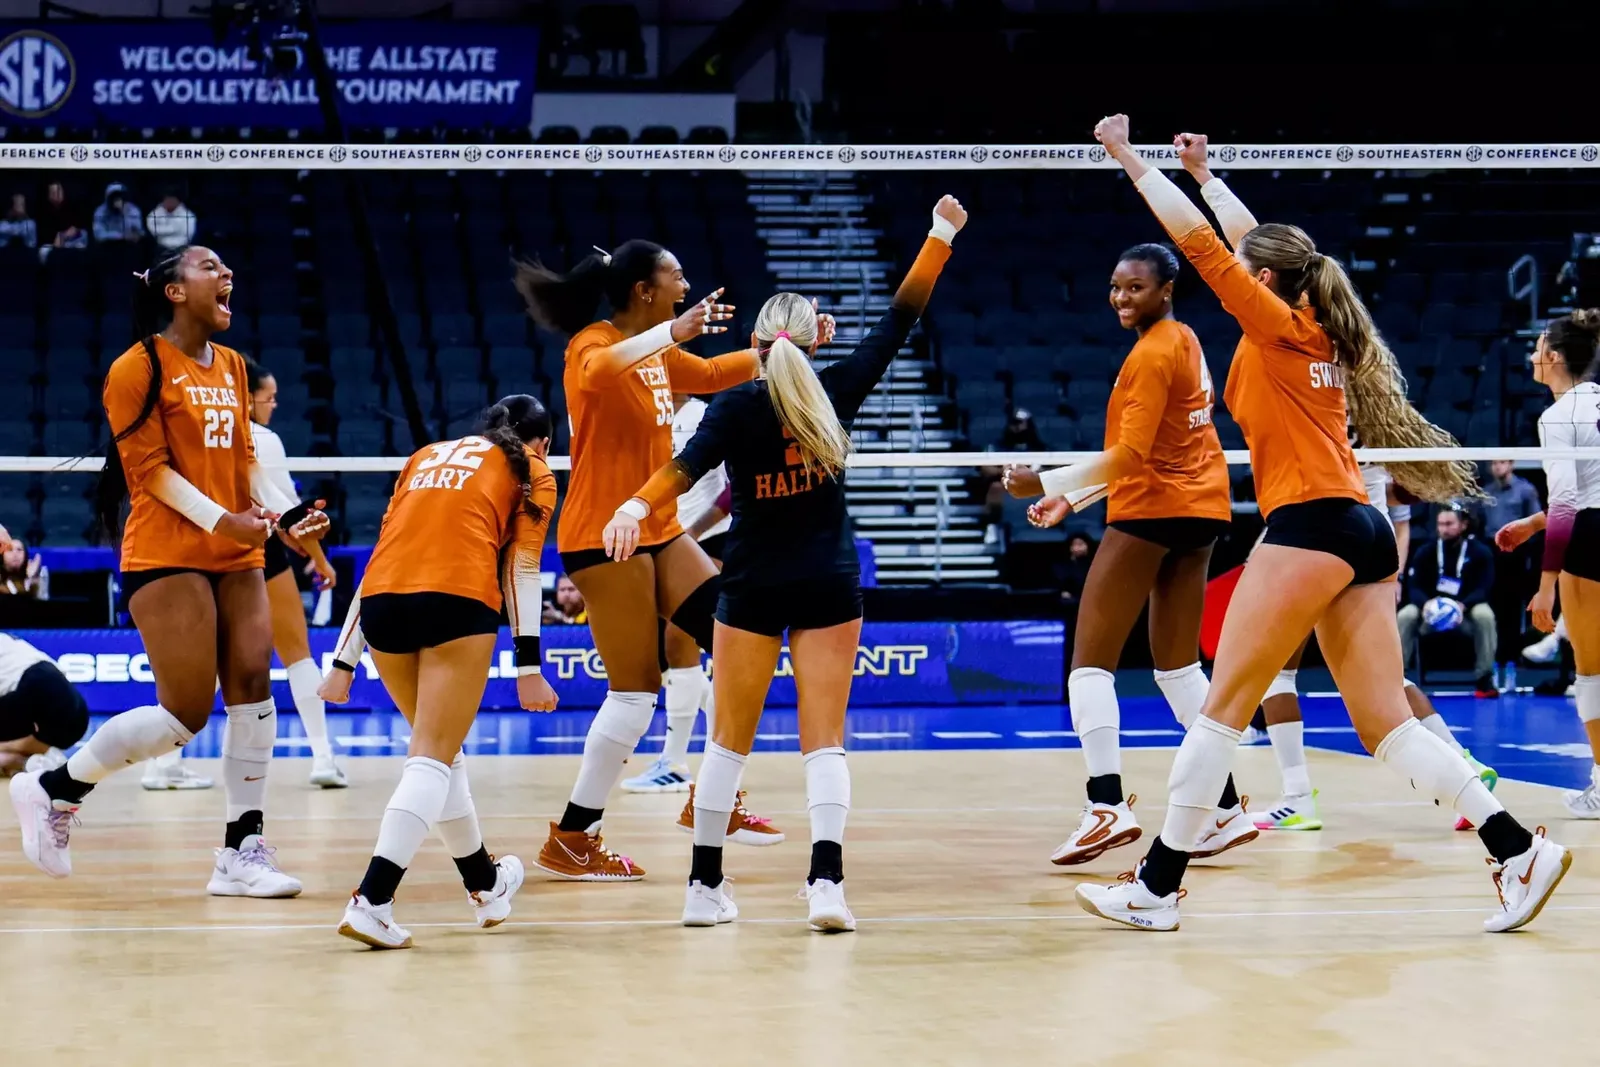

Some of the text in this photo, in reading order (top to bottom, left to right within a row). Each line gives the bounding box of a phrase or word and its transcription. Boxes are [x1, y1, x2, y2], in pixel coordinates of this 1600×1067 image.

[324, 46, 362, 71] HE
[368, 46, 498, 71] ALLSTATE
[0, 37, 67, 110] SEC
[93, 79, 144, 104] SEC
[93, 149, 203, 160] SOUTHEASTERN
[228, 149, 325, 160] CONFERENCE
[351, 149, 461, 160] SOUTHEASTERN
[485, 149, 581, 160] CONFERENCE
[607, 149, 715, 160] SOUTHEASTERN
[740, 149, 834, 160] CONFERENCE
[860, 149, 967, 160] SOUTHEASTERN
[991, 149, 1084, 160] CONFERENCE
[1240, 149, 1332, 160] CONFERENCE
[1357, 149, 1462, 160] SOUTHEASTERN
[1486, 148, 1578, 159] CONFERENCE
[635, 365, 668, 386] TEX
[185, 386, 239, 407] TEXAS
[652, 388, 675, 426] 55
[204, 408, 235, 449] 23
[417, 435, 496, 470] 32
[407, 467, 474, 491] GARY
[57, 653, 156, 683] SEC
